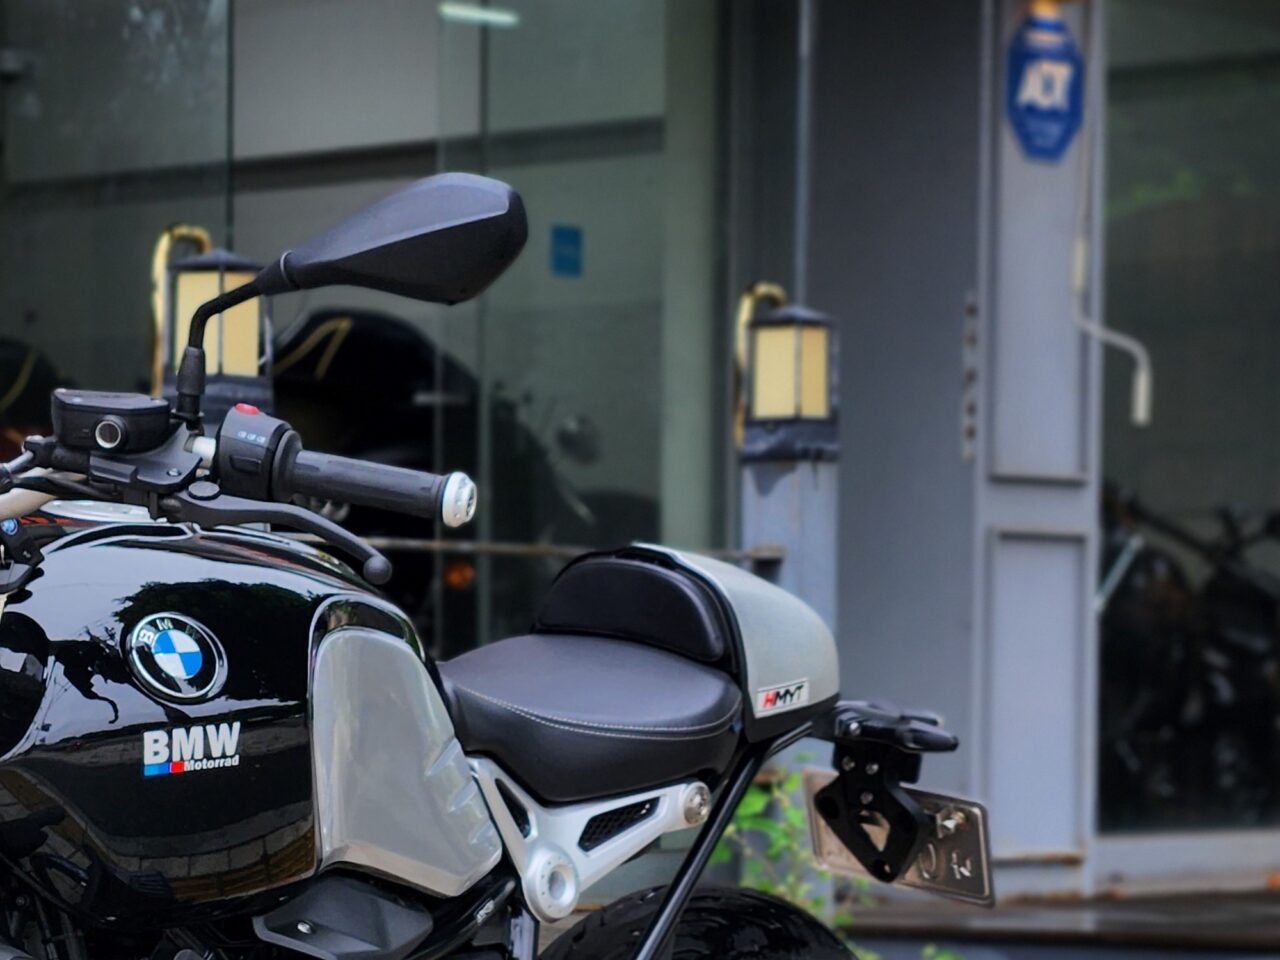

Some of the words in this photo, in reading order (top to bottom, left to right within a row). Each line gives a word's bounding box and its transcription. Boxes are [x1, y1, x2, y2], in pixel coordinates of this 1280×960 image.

[1017, 61, 1073, 109] ADT
[143, 721, 241, 765] BMW
[183, 754, 240, 772] Motorrad
